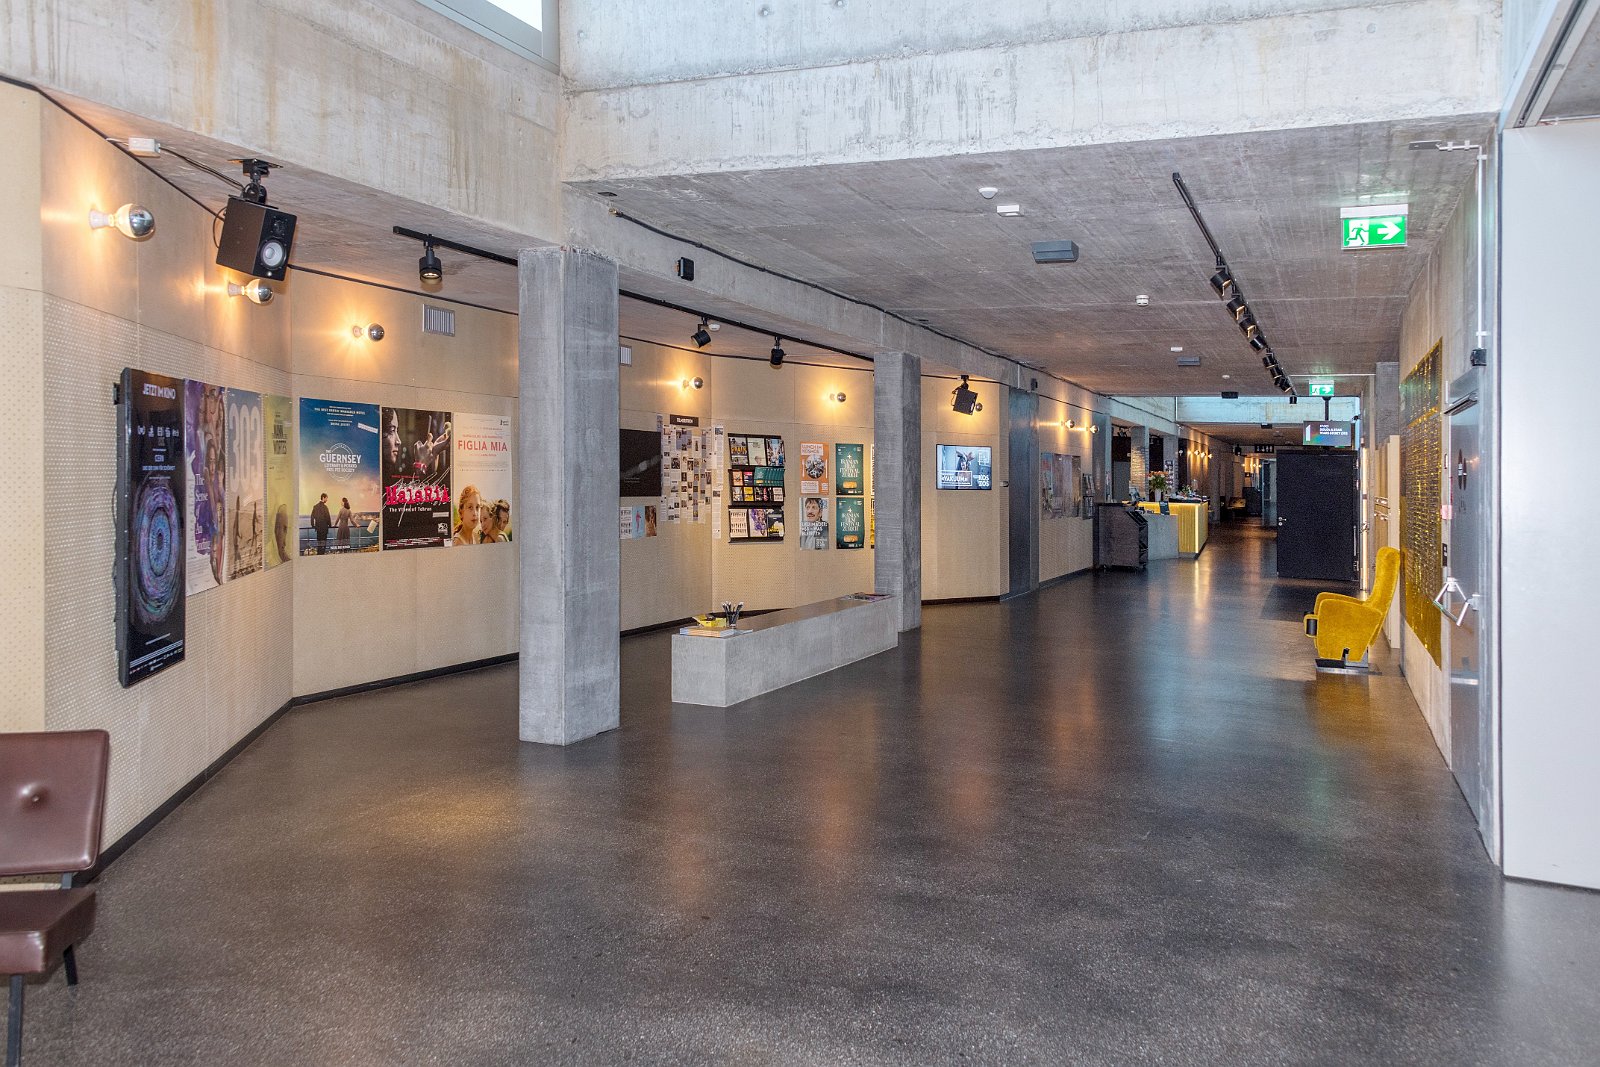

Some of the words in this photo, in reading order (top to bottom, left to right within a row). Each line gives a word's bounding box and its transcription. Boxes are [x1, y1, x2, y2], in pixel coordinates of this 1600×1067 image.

[228, 402, 262, 493] 303
[458, 440, 487, 450] FIGLIA
[491, 441, 508, 451] MIA
[319, 453, 362, 463] GUERNSEY
